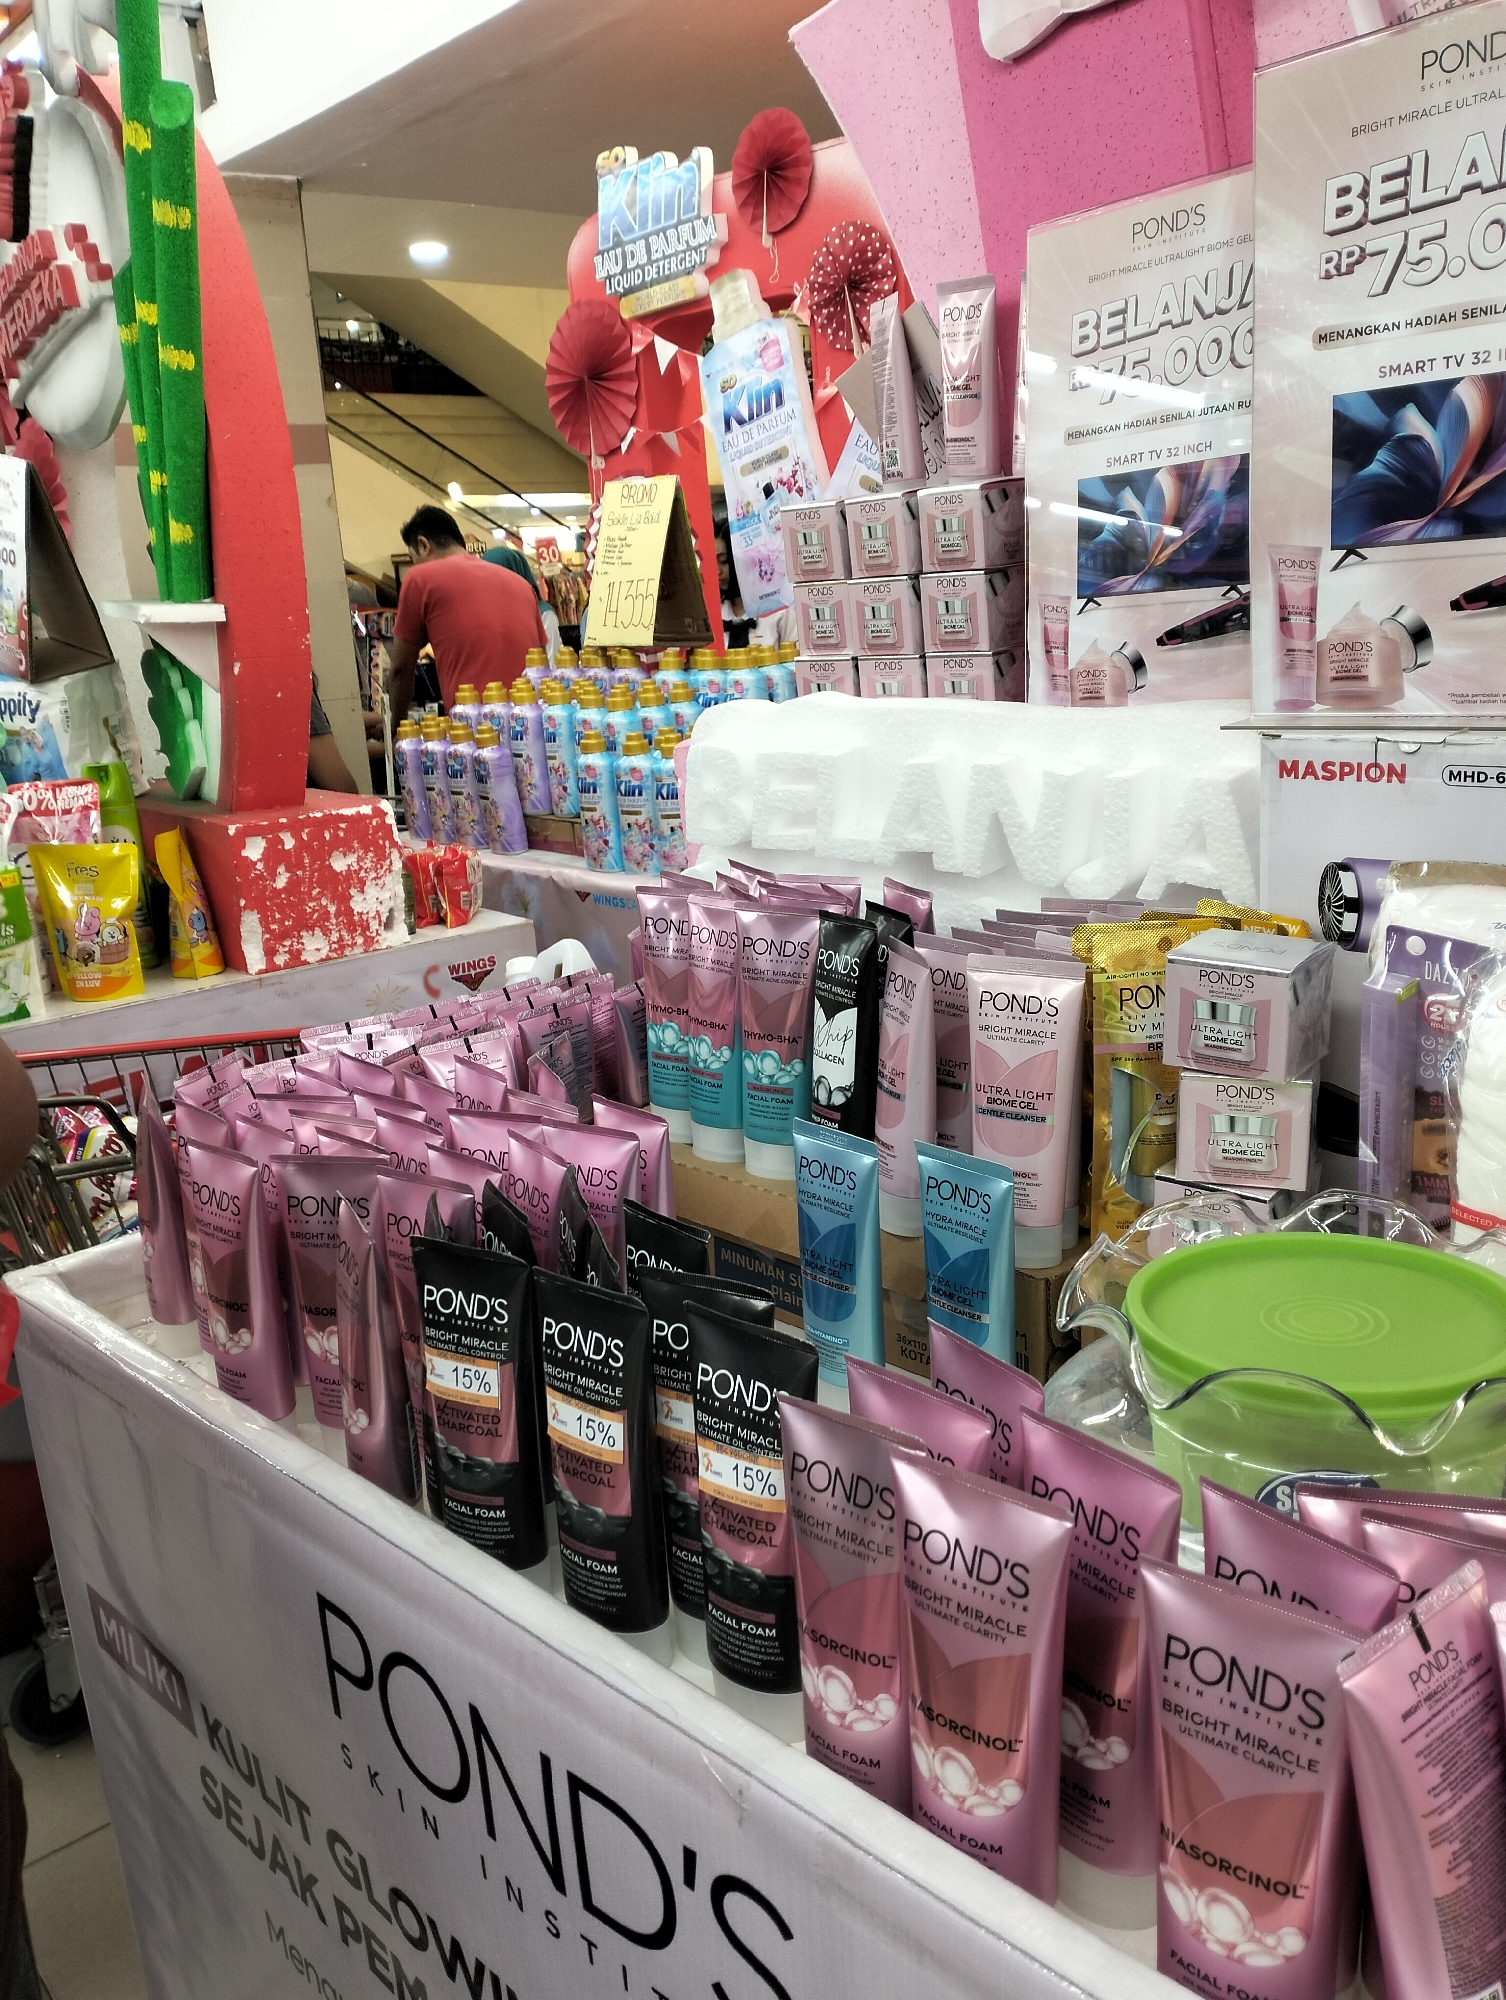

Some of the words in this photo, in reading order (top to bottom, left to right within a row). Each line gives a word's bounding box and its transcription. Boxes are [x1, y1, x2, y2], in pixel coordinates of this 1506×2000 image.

[1421, 78, 1451, 92] SKIN
[1351, 117, 1394, 138] BRIGHT
[1398, 101, 1453, 126] MIRACLE
[596, 147, 625, 176] SO
[1323, 124, 1506, 237] BELA
[597, 151, 699, 250] Klin
[1132, 204, 1206, 244] POND'S
[1132, 243, 1152, 252] SKIN
[1157, 227, 1206, 246] INSTITUTE
[594, 249, 623, 280] EAU
[626, 239, 648, 269] DE
[650, 215, 718, 259] PARFUM
[1088, 269, 1117, 284] BRIGHT
[1118, 259, 1153, 276] MIRACLE
[1154, 245, 1205, 266] ULTRALIGHT
[1207, 237, 1235, 252] BIOME
[605, 268, 643, 296] LIQUID
[645, 247, 708, 281] DETERGENT
[943, 302, 983, 323] POND'S
[1318, 321, 1401, 344] MENANGKAN
[1405, 311, 1457, 330] HADIAH
[1378, 357, 1437, 379] SMART
[1443, 353, 1466, 369] TV
[1471, 349, 1492, 366] 32
[722, 374, 787, 435] Klin
[1067, 423, 1121, 441] MENANGKAN
[1123, 417, 1158, 430] HADIAH
[1159, 409, 1195, 424] SENILAI
[1197, 402, 1235, 417] JUTAAN
[1237, 399, 1252, 410] RU
[722, 433, 740, 454] EAU
[741, 427, 755, 445] DE
[757, 408, 797, 438] PARFUM
[1106, 452, 1145, 468] SMART
[1148, 449, 1163, 460] TV
[1166, 447, 1180, 458] 32
[1183, 441, 1213, 456] INCH
[620, 483, 658, 504] PROMO
[538, 544, 560, 564] 30
[1278, 557, 1317, 571] POND'S
[1328, 641, 1374, 655] POND'S
[1278, 759, 1407, 785] MASPION
[1448, 769, 1506, 784] MHD-6
[684, 742, 1259, 907] BELANJA
[690, 925, 738, 950] POND'S
[743, 936, 810, 960] POND'S
[447, 956, 497, 976] WINGS
[742, 967, 771, 977] BRIGHT
[772, 969, 808, 980] MIRACLE
[817, 949, 860, 977] POND'S
[1199, 969, 1255, 989] POND'S
[979, 990, 1059, 1018] POND'S
[978, 1024, 1013, 1036] BRIGHT
[1014, 1026, 1057, 1040] MIRACLE
[986, 1034, 1018, 1043] ULTIMATE
[1019, 1038, 1046, 1046] CLARITY
[1190, 1024, 1225, 1037] ULTRA
[1227, 1029, 1258, 1041] LIGHT
[1203, 1034, 1229, 1045] BIOME
[1229, 1037, 1245, 1047] GEL
[770, 1096, 794, 1105] FOAM
[975, 1083, 1011, 1097] ULTRA
[1015, 1088, 1054, 1101] LIGHT
[986, 1097, 1018, 1109] BIOME
[1019, 1100, 1039, 1111] GEL
[1216, 1084, 1275, 1101] POND'S
[978, 1107, 1005, 1120] GENTLE
[1005, 1111, 1047, 1124] CLEANSER
[1207, 1138, 1242, 1148] ULTRA
[1246, 1141, 1280, 1151] LIGHT
[799, 1156, 857, 1191] POND'S
[192, 1184, 241, 1217] POND'S
[798, 1188, 822, 1202] HYDRA
[823, 1196, 854, 1213] MIRACLE
[926, 1176, 992, 1215] POND'S
[925, 1210, 954, 1225] HYDRA
[954, 1219, 988, 1238] MIRACLE
[721, 1248, 785, 1282] MINUMAN
[424, 1284, 509, 1324] POND'S
[931, 1284, 957, 1302] BIOME
[425, 1326, 459, 1342] BRIGHT
[461, 1335, 510, 1351] MIRACLE
[542, 1316, 624, 1367] POND'S
[452, 1365, 492, 1394] 15%
[576, 1375, 624, 1397] MIRACLE
[576, 1414, 616, 1447] 15%
[732, 1462, 777, 1497] 15%
[790, 1451, 896, 1520] POND'S
[704, 1499, 776, 1533] ACTIVATED
[704, 1514, 778, 1548] CHARCOAL
[791, 1506, 833, 1531] BRIGHT
[835, 1525, 895, 1556] MIRACLE
[903, 1519, 1030, 1599] POND'S
[708, 1603, 739, 1629] FACIAL
[741, 1622, 776, 1638] FOAM
[904, 1575, 953, 1609] BRIGHT
[956, 1602, 1027, 1637] MIRACLE
[98, 1605, 182, 1710] MILIKI
[1163, 1633, 1327, 1730] POND'S
[1162, 1697, 1231, 1736] BRIGHT
[1235, 1728, 1320, 1774] MIRACLE
[1178, 1723, 1239, 1755] ULTIMATE
[1242, 1749, 1296, 1779] CLARITY
[200, 1703, 312, 1845] KULIT
[316, 1591, 795, 2000] POND'S
[340, 1743, 440, 1840] SKIN
[200, 1765, 328, 1927] SEJAK
